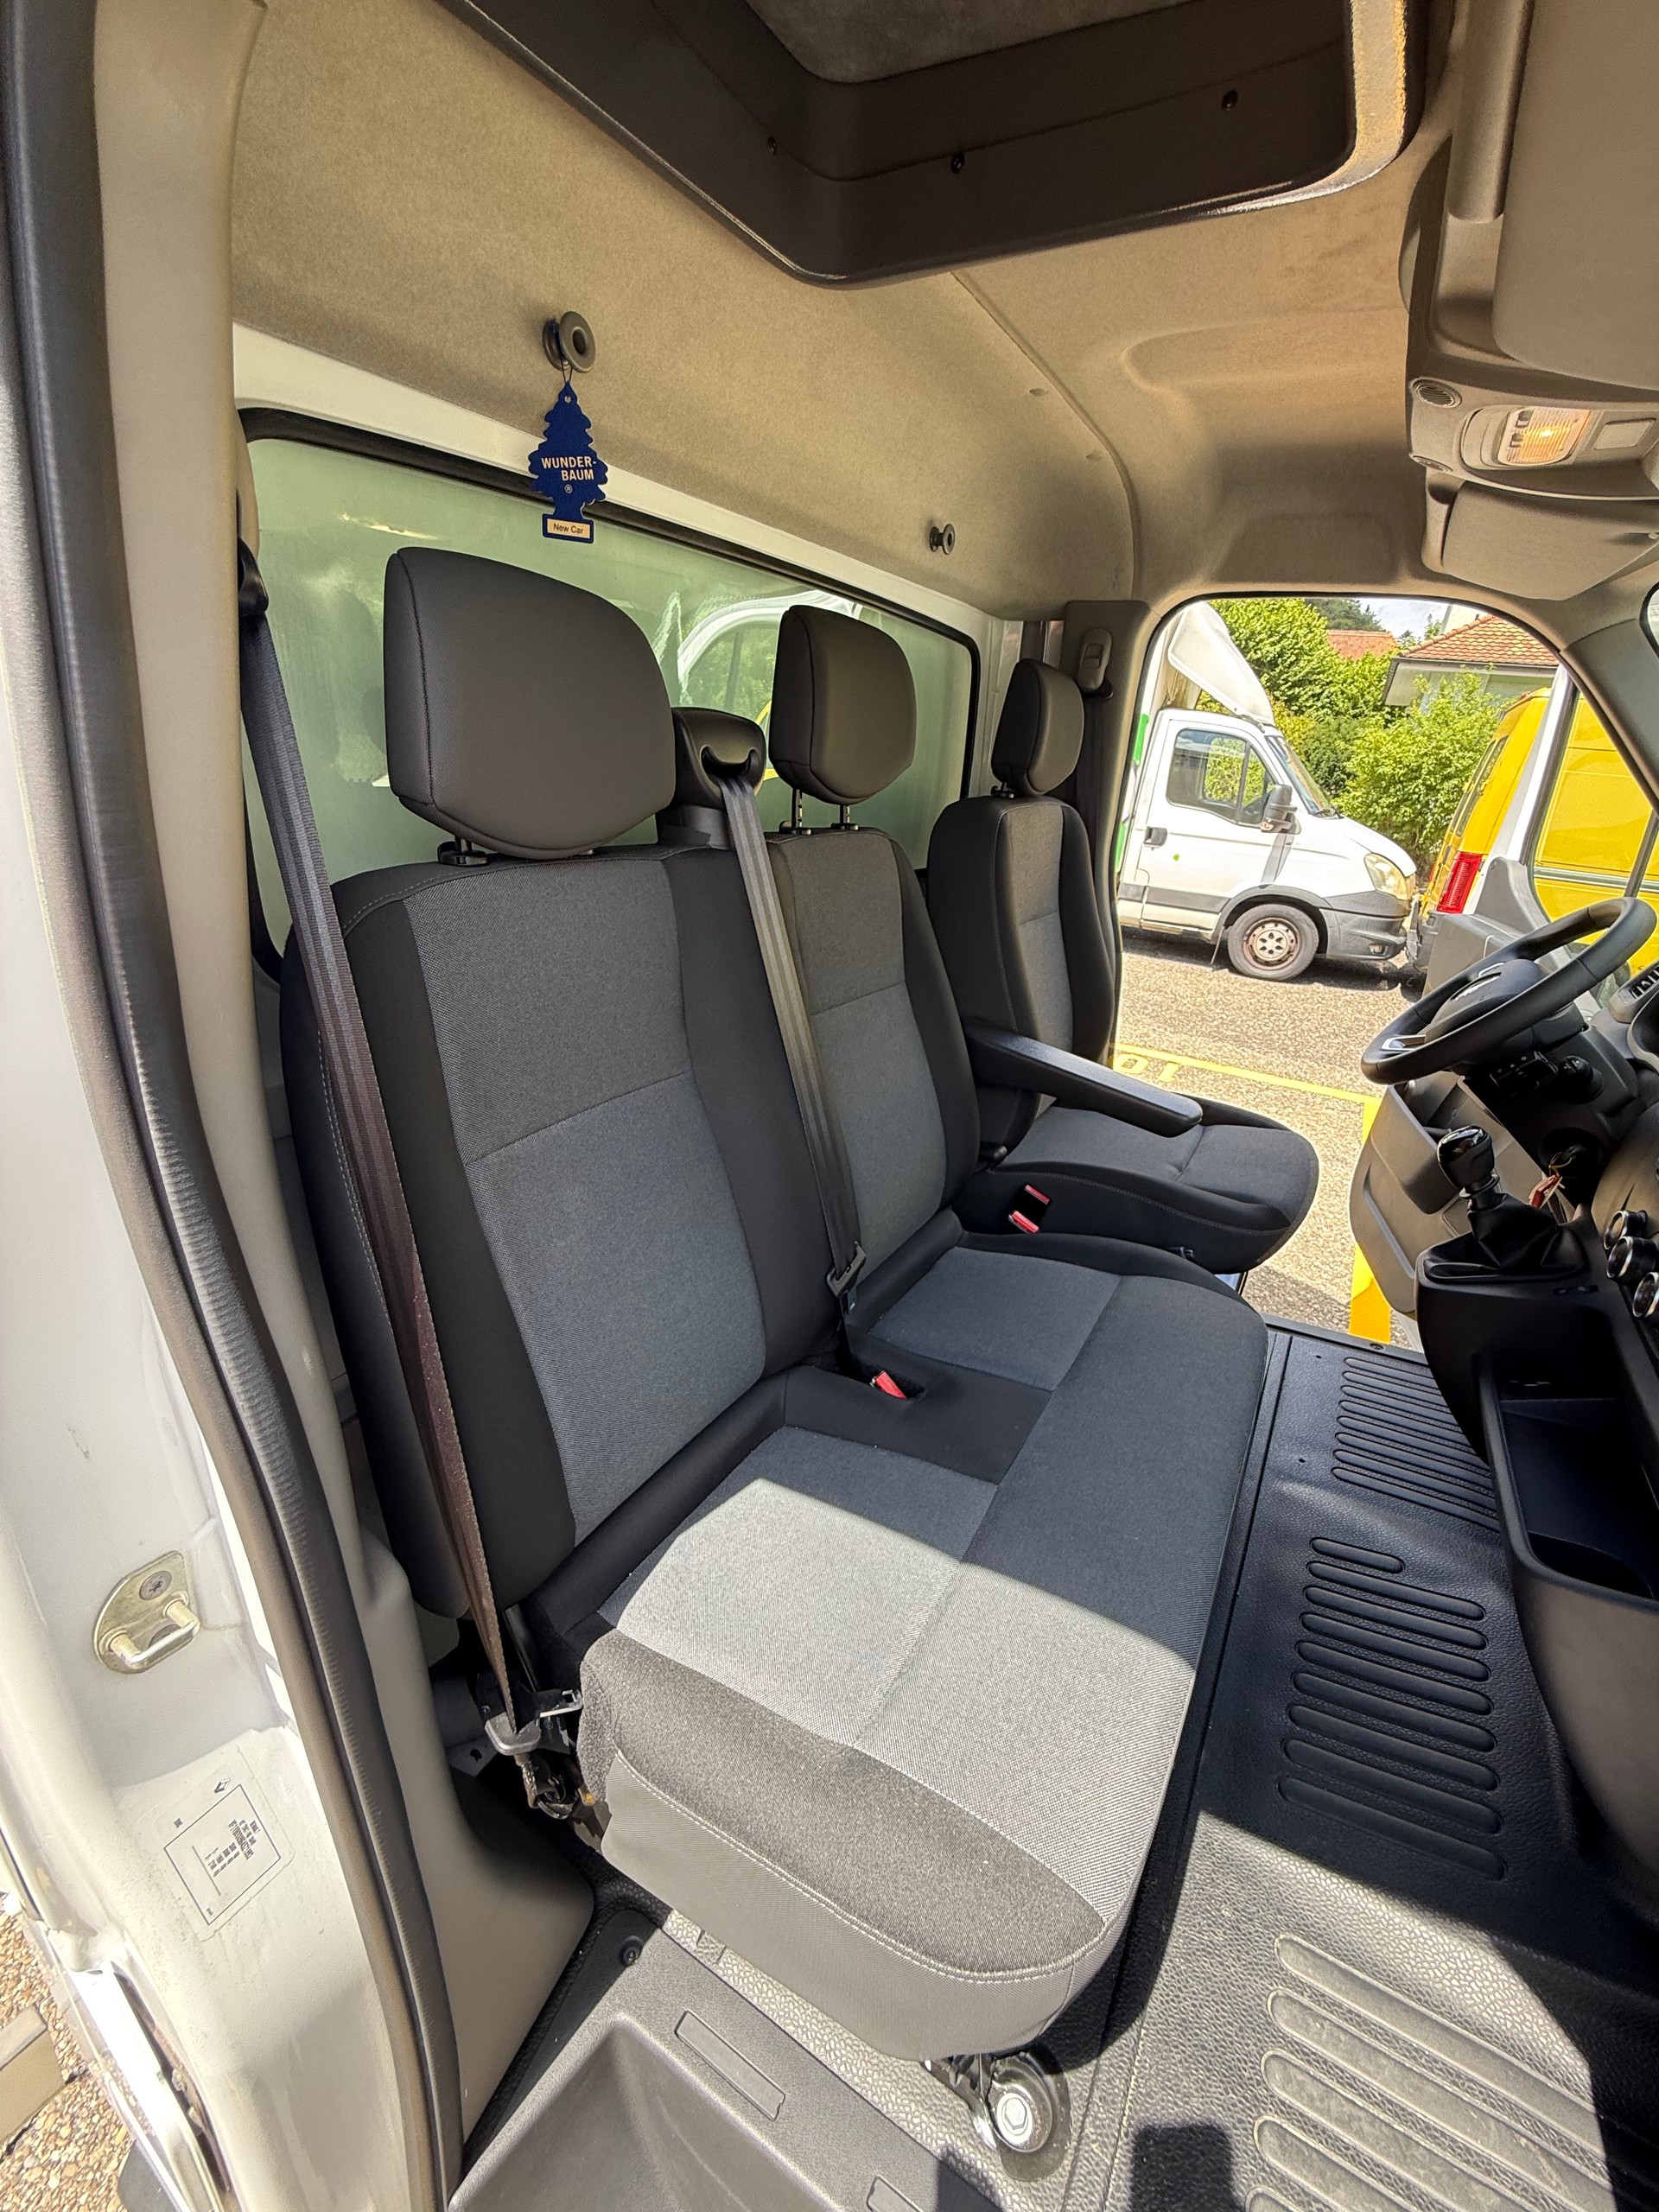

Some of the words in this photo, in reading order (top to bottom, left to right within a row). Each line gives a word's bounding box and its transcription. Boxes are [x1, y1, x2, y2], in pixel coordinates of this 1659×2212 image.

[541, 456, 597, 469] WUNDER-
[561, 468, 594, 481] BAUM
[553, 523, 569, 532] New
[570, 525, 584, 534] Car
